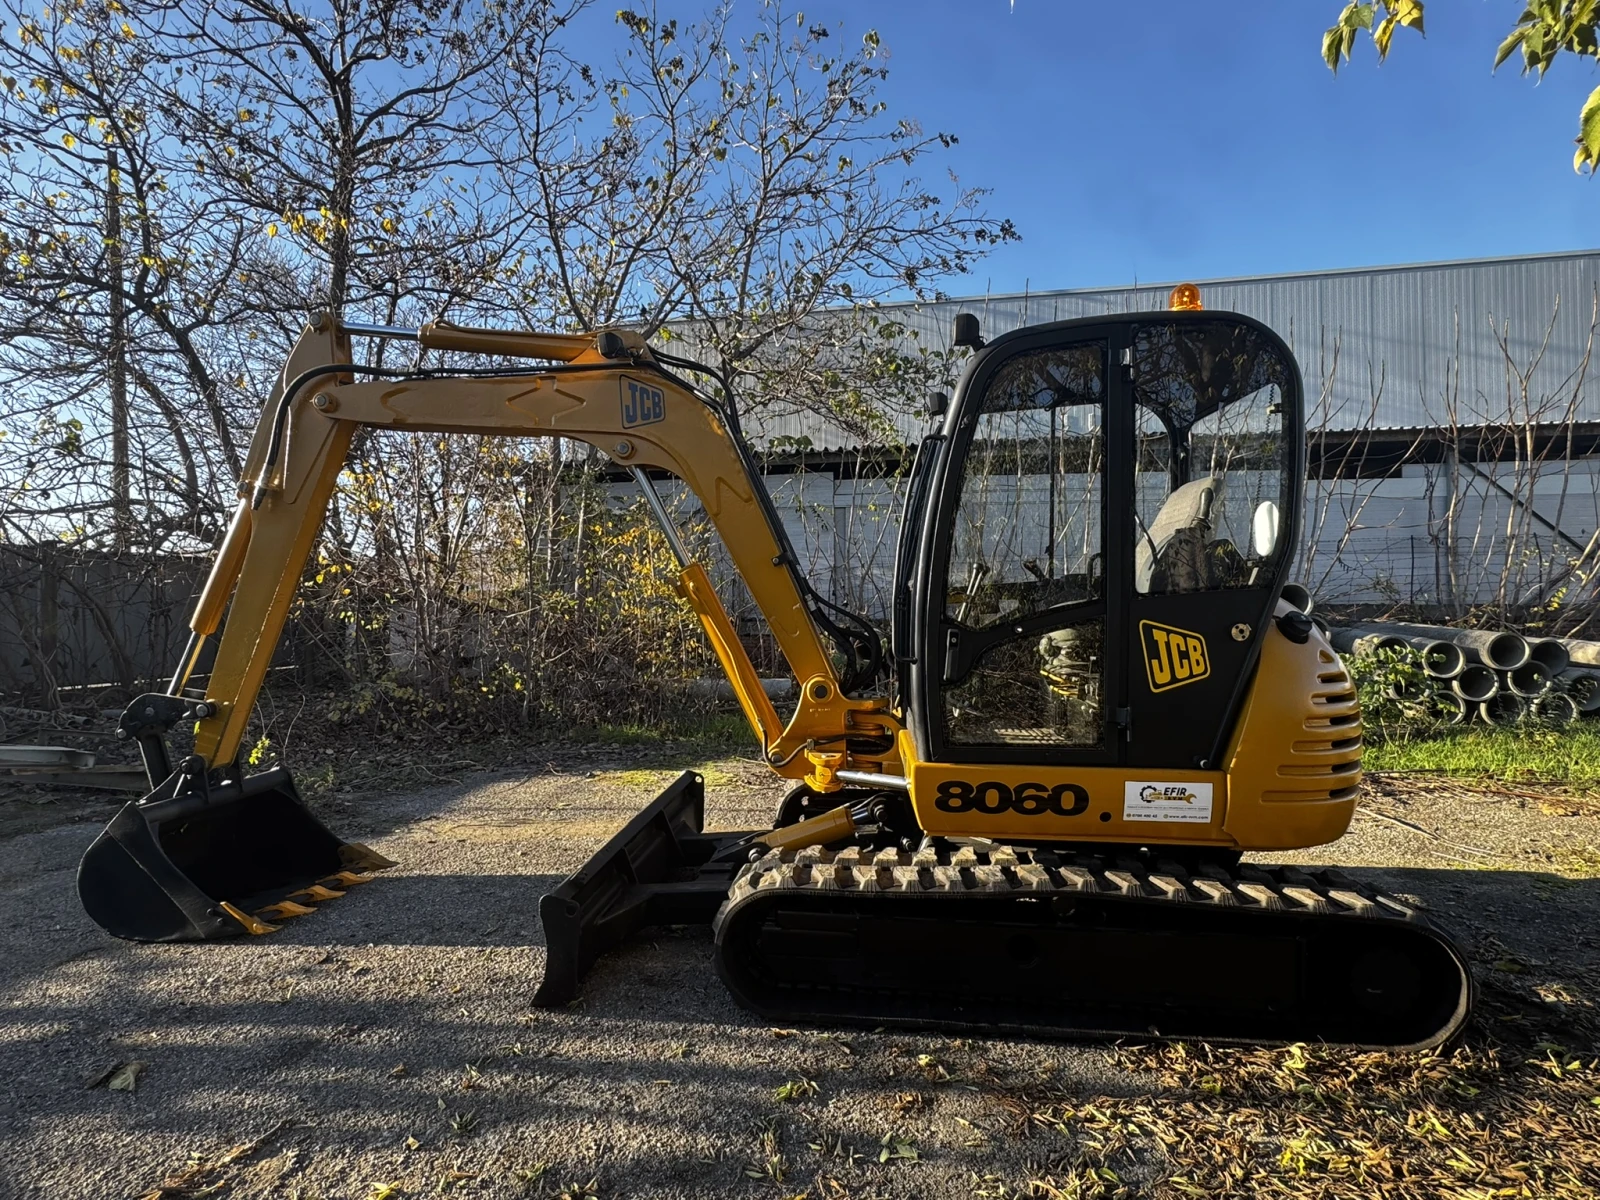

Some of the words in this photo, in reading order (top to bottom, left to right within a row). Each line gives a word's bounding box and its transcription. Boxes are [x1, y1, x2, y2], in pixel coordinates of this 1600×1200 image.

[625, 382, 663, 424] JCB
[1151, 628, 1205, 685] JCB
[934, 780, 1090, 817] 8060
[1163, 787, 1187, 796] EFIR
